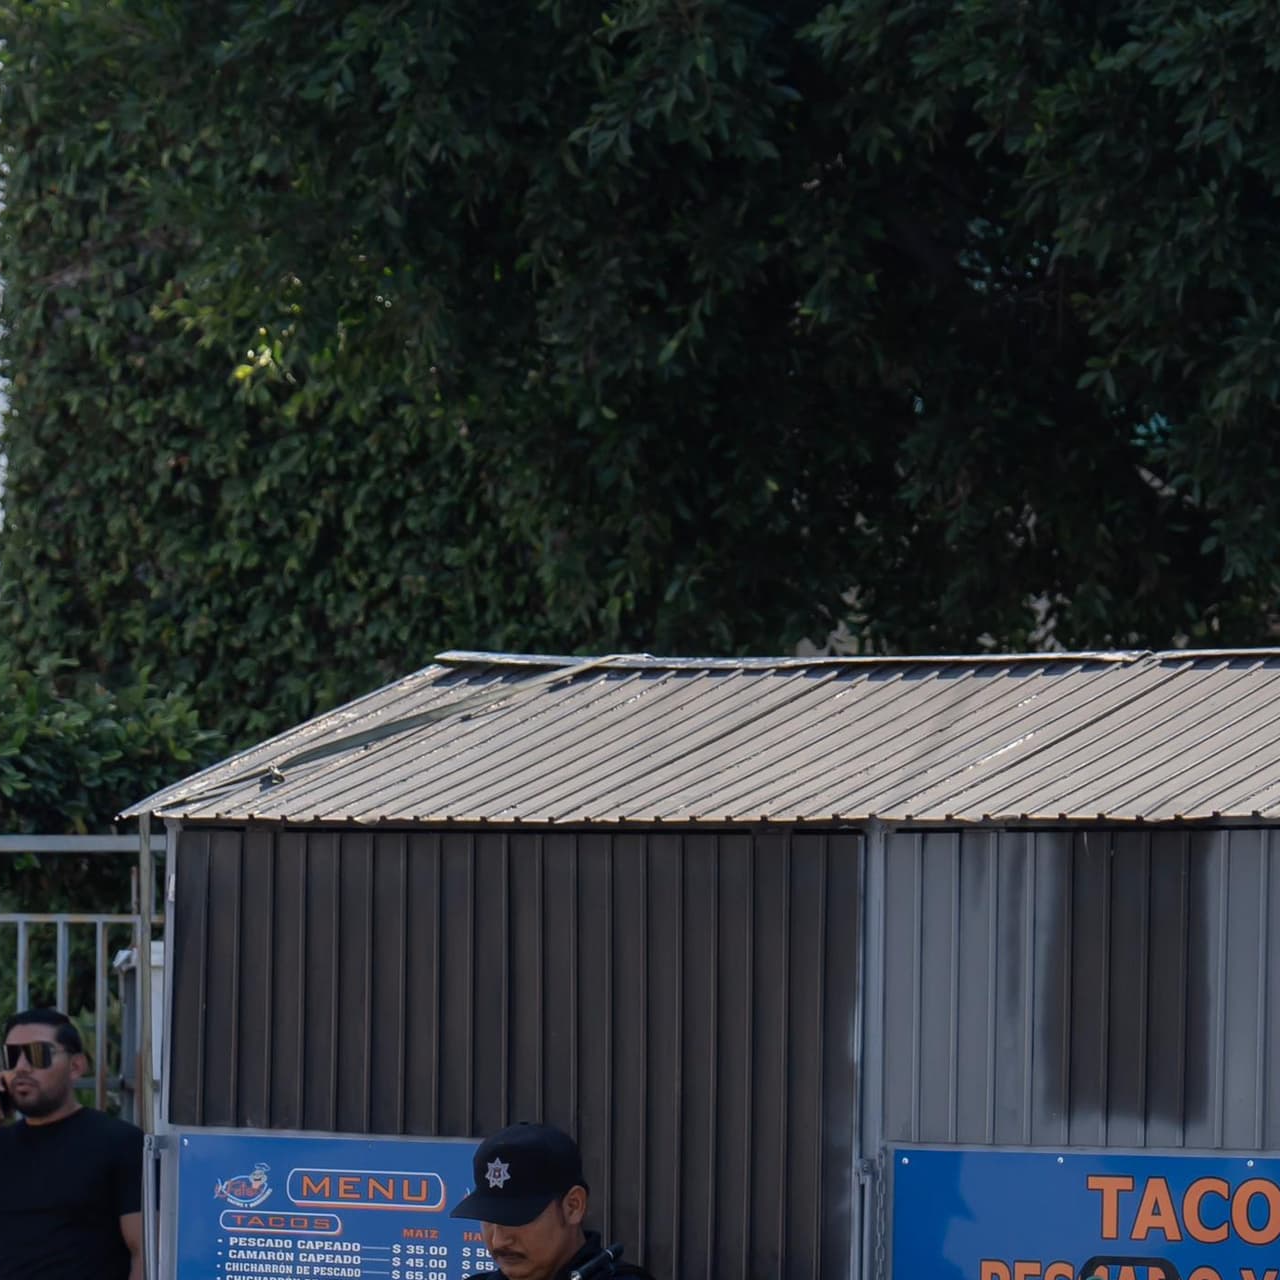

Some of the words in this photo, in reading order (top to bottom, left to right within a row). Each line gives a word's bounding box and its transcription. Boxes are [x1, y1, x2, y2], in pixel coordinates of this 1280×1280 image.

[302, 1175, 428, 1202] MENU
[232, 1215, 331, 1230] TACOS
[403, 1229, 439, 1239] MAIZ
[229, 1236, 292, 1249] PESCADO
[297, 1240, 361, 1252] CAPEADO
[406, 1245, 448, 1256] 35.00
[229, 1249, 294, 1262] CAMARÓN
[299, 1253, 361, 1265] CAPEADO
[406, 1257, 447, 1269] 45.00
[225, 1262, 293, 1275] CHICHARRÓN
[296, 1266, 310, 1276] DE
[313, 1266, 361, 1278] PESCADO
